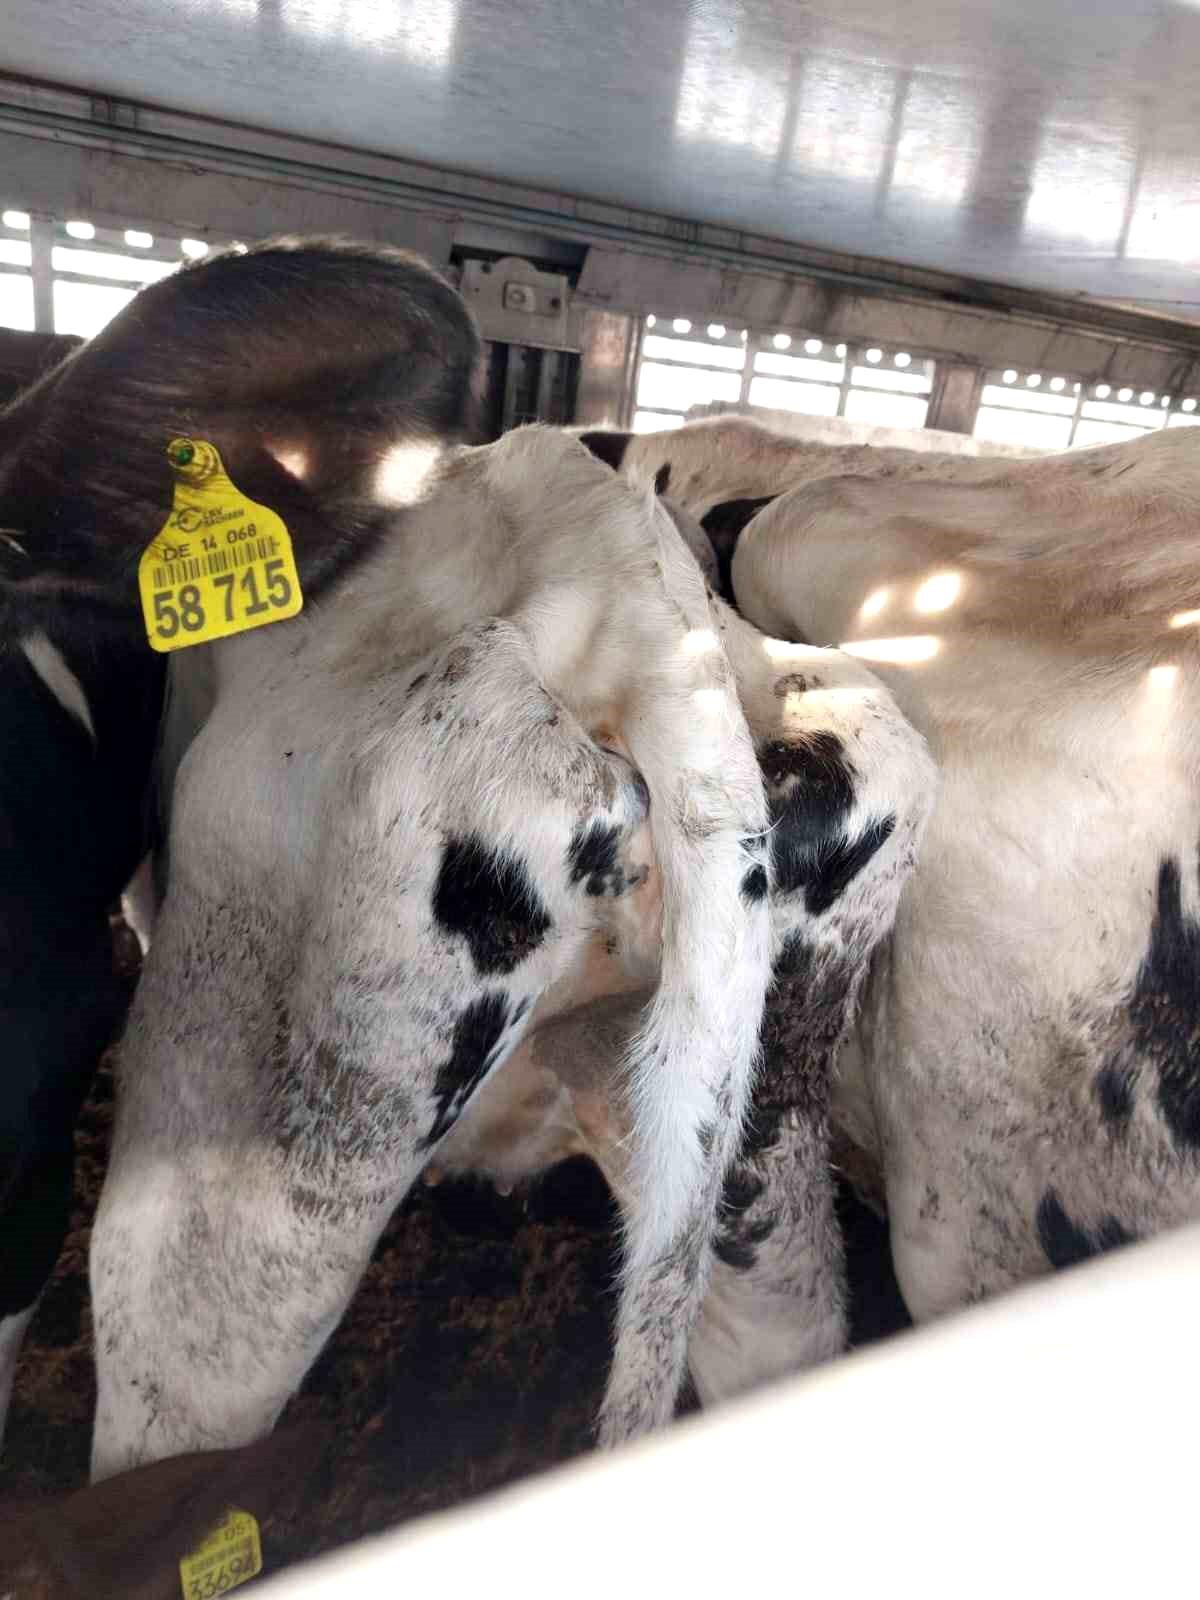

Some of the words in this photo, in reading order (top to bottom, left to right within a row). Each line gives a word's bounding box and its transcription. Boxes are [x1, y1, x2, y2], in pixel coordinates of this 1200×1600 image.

[163, 543, 191, 561] DE
[201, 535, 217, 550] 14
[227, 523, 256, 544] 068
[153, 585, 206, 639] 58
[213, 558, 292, 622] 715
